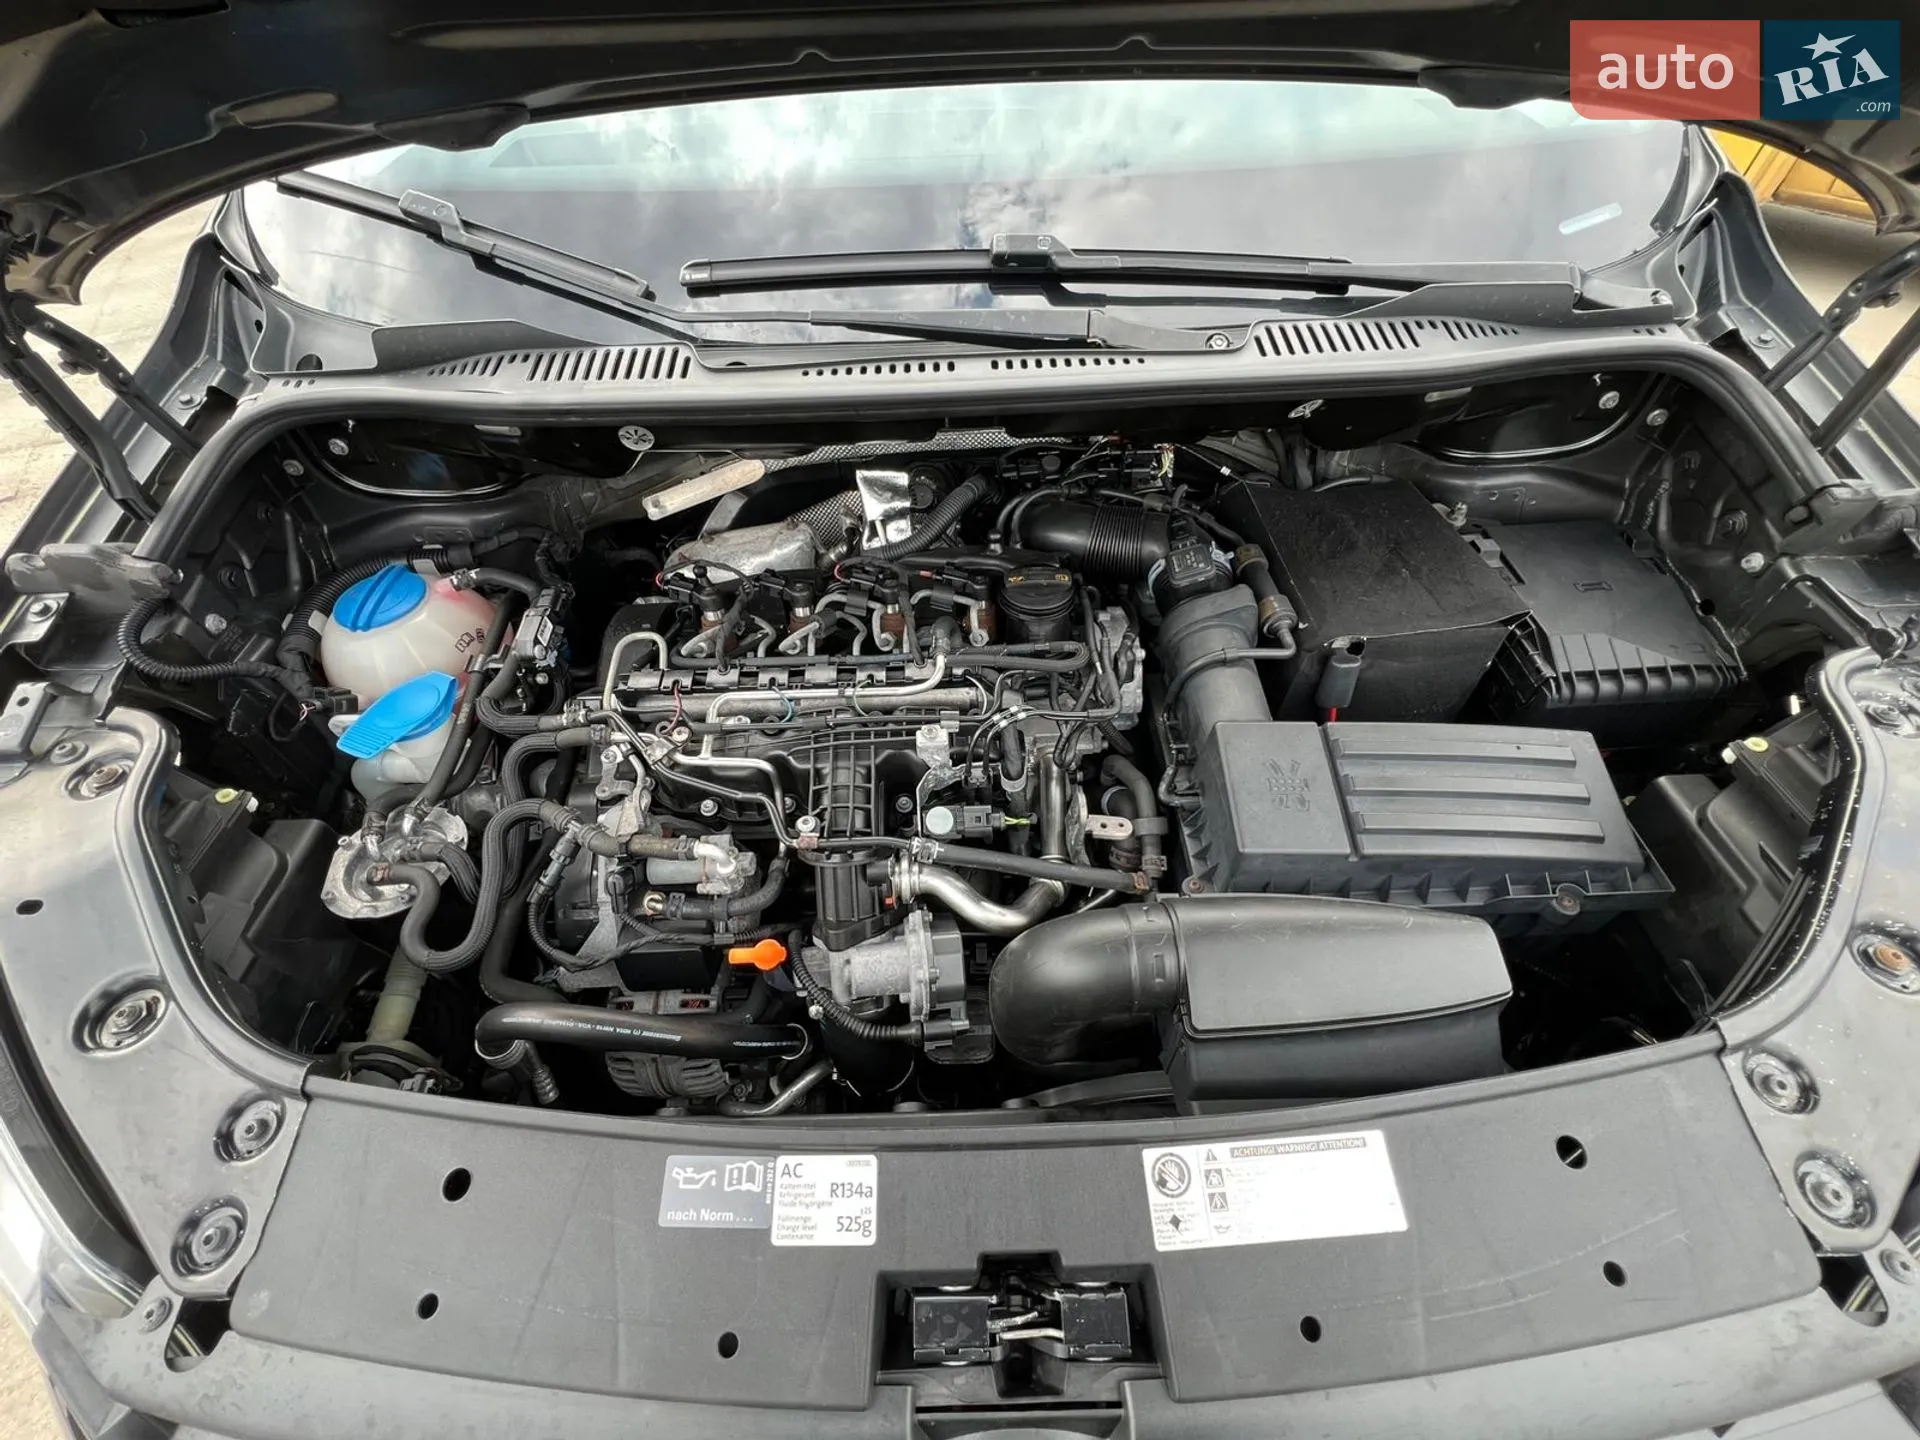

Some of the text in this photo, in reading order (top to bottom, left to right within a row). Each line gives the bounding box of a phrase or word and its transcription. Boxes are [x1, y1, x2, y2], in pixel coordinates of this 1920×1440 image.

[1233, 1138, 1364, 1157] ACHTUNG! WARNING! ATTENTION!
[780, 1163, 804, 1178] AC
[830, 1182, 873, 1199] R134a
[667, 1209, 697, 1221] nach
[700, 1209, 733, 1221] Norm
[836, 1216, 872, 1238] 525g
